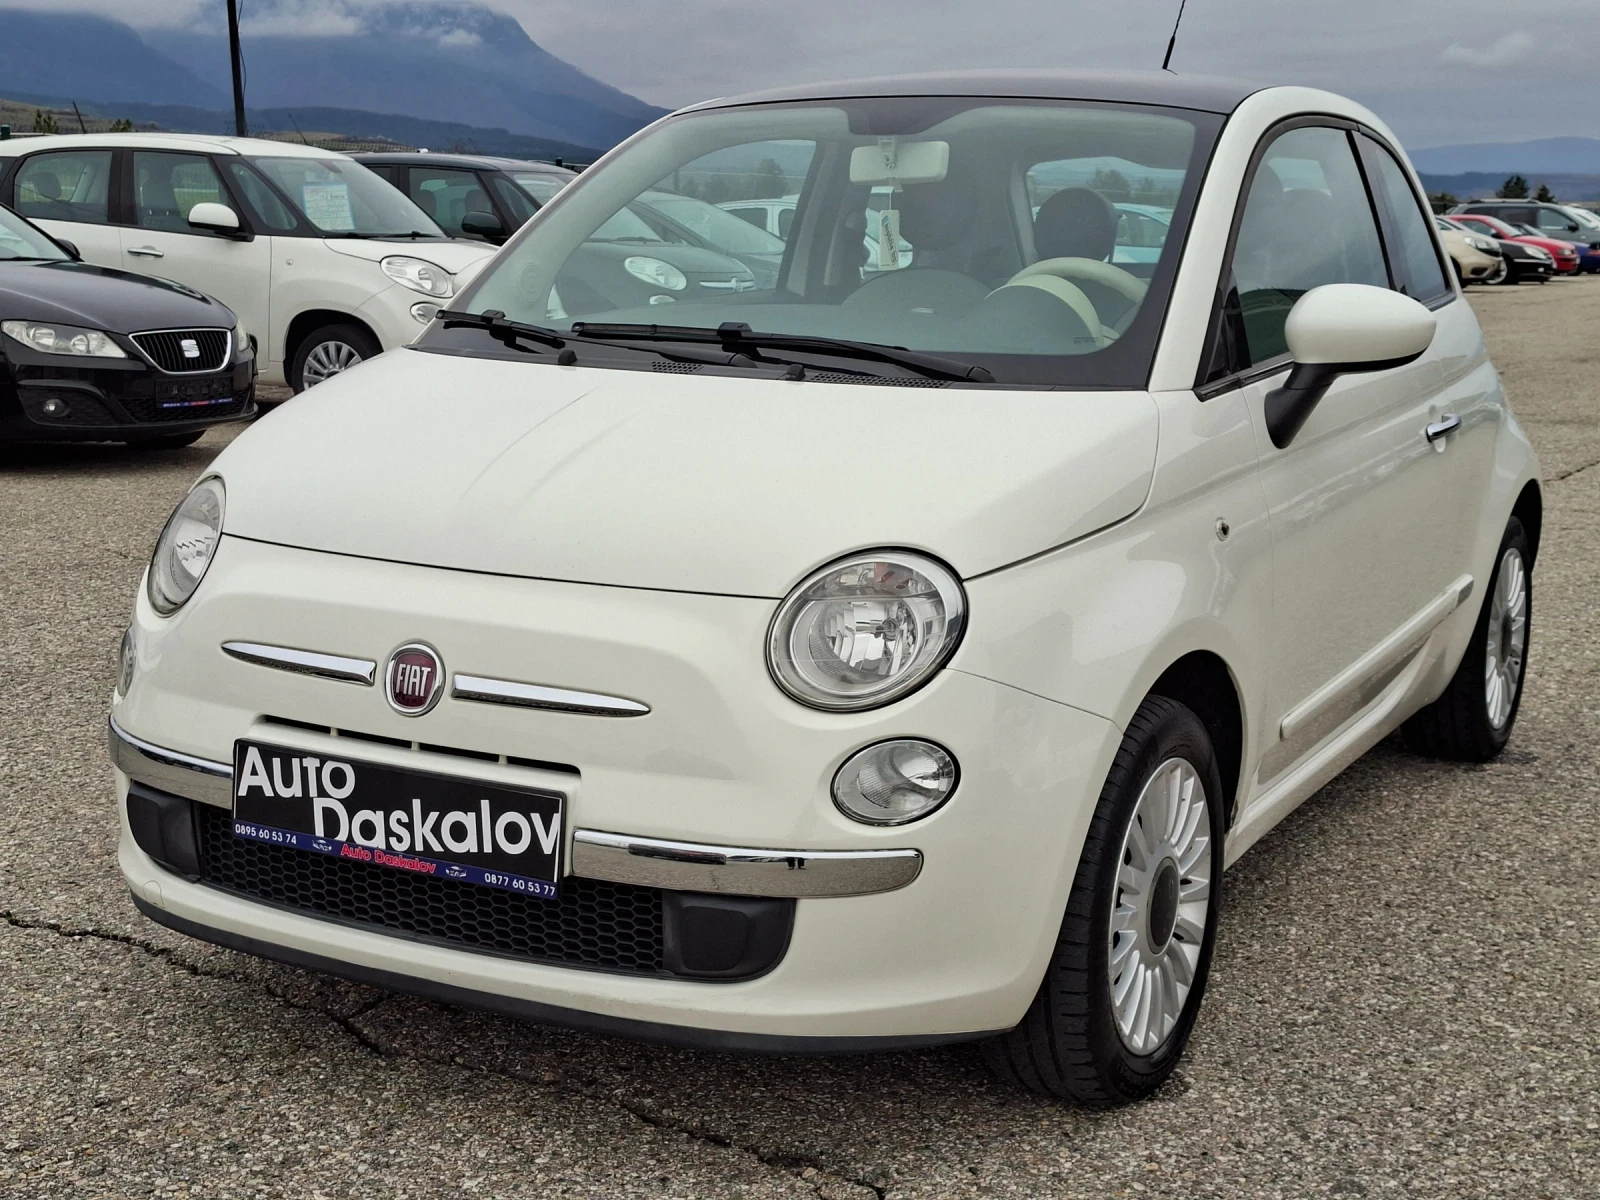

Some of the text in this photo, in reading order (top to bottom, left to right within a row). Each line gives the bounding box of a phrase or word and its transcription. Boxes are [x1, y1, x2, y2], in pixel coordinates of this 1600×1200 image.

[395, 663, 432, 697] FIAT
[235, 824, 297, 845] 0895 60 53 74
[340, 843, 437, 874] Auto Daskalov
[484, 872, 556, 896] 0877 60 53 77
